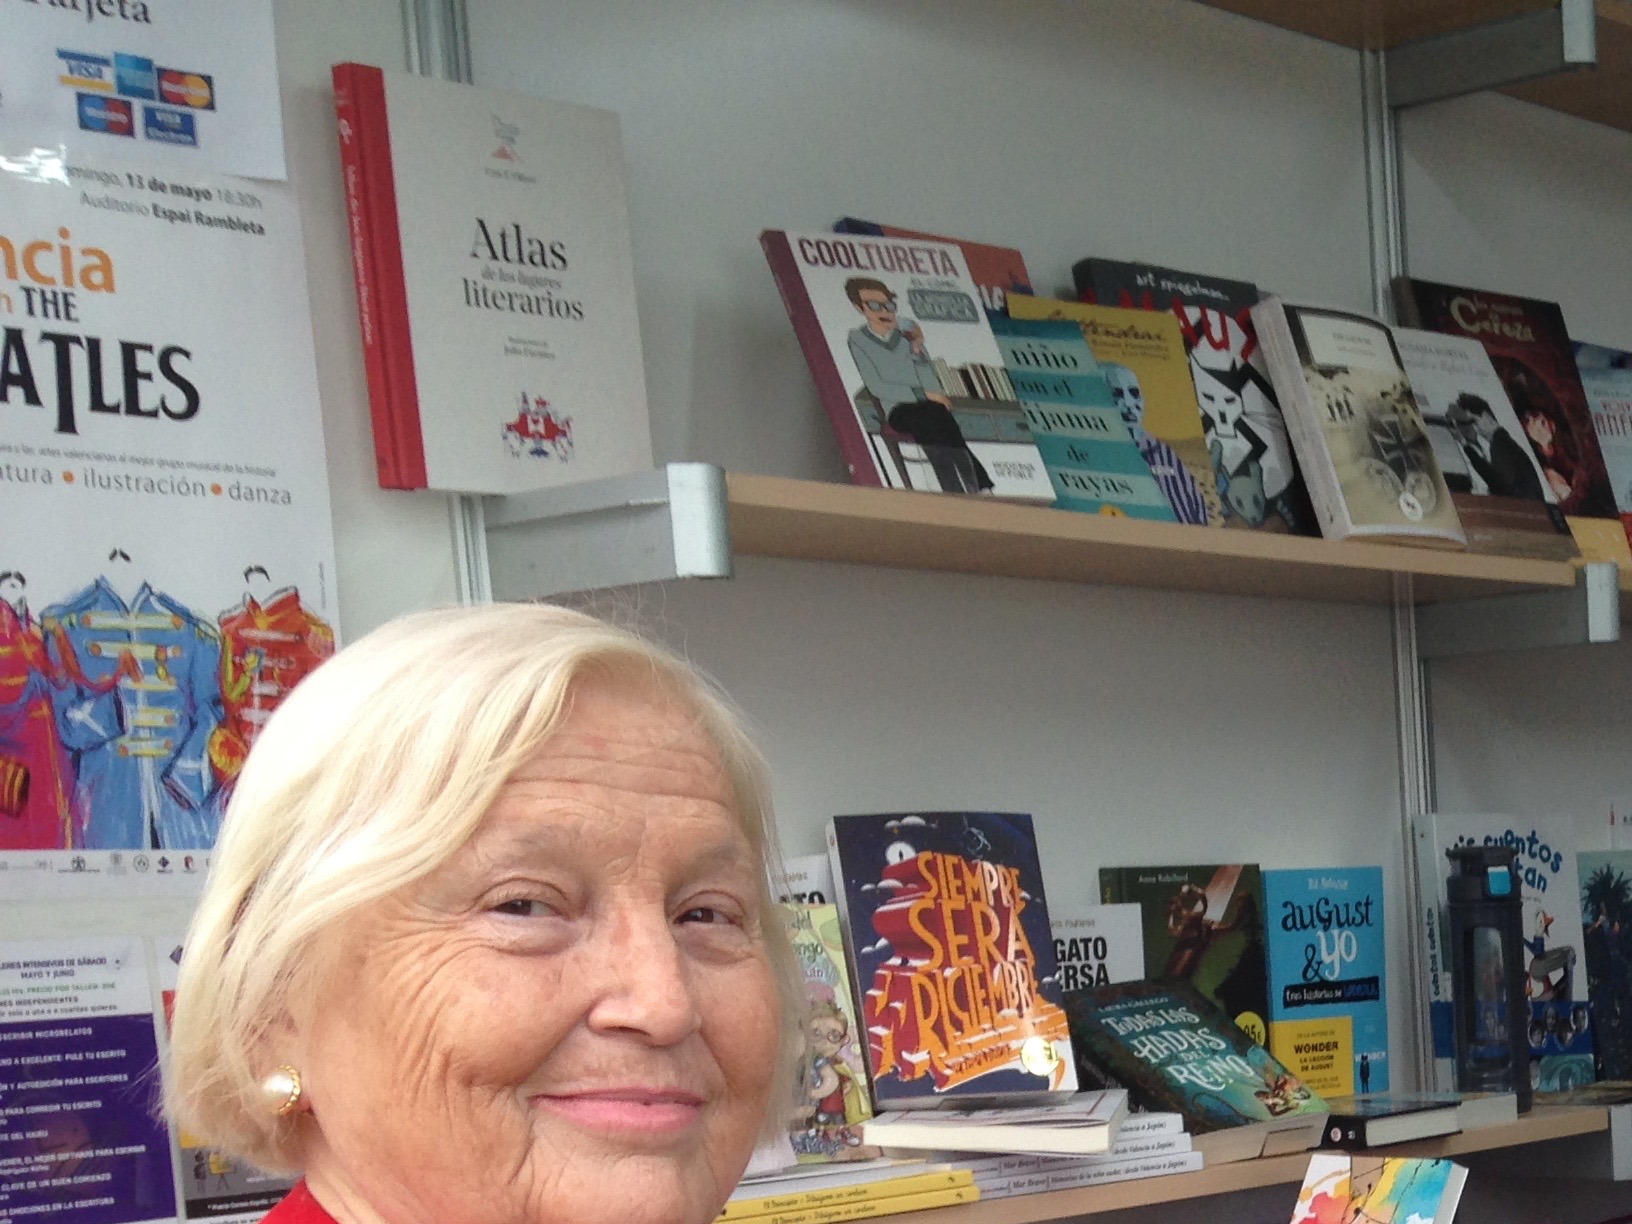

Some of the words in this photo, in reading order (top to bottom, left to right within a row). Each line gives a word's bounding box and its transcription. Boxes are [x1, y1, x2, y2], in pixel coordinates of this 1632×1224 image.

[148, 177, 168, 193] de
[170, 183, 212, 202] mayo
[151, 203, 192, 223] Espai
[194, 210, 265, 236] Rambleta
[470, 216, 568, 272] Atlas
[798, 237, 960, 278] COOLTURETA
[20, 285, 79, 323] THE
[462, 277, 584, 322] literarios
[1011, 342, 1078, 369] niño
[83, 468, 206, 498] ilustración
[228, 480, 292, 505] danza
[1058, 470, 1133, 498] rayas
[917, 850, 1021, 908] SIEMPRE
[908, 898, 1037, 972] SERÁ
[1302, 943, 1325, 982] &
[1316, 929, 1358, 981] yo
[911, 958, 1040, 1060] DICIEMBRE
[1129, 1027, 1227, 1063] HADAS
[1294, 1041, 1339, 1054] WONDER
[1166, 1054, 1256, 1092] REINO
